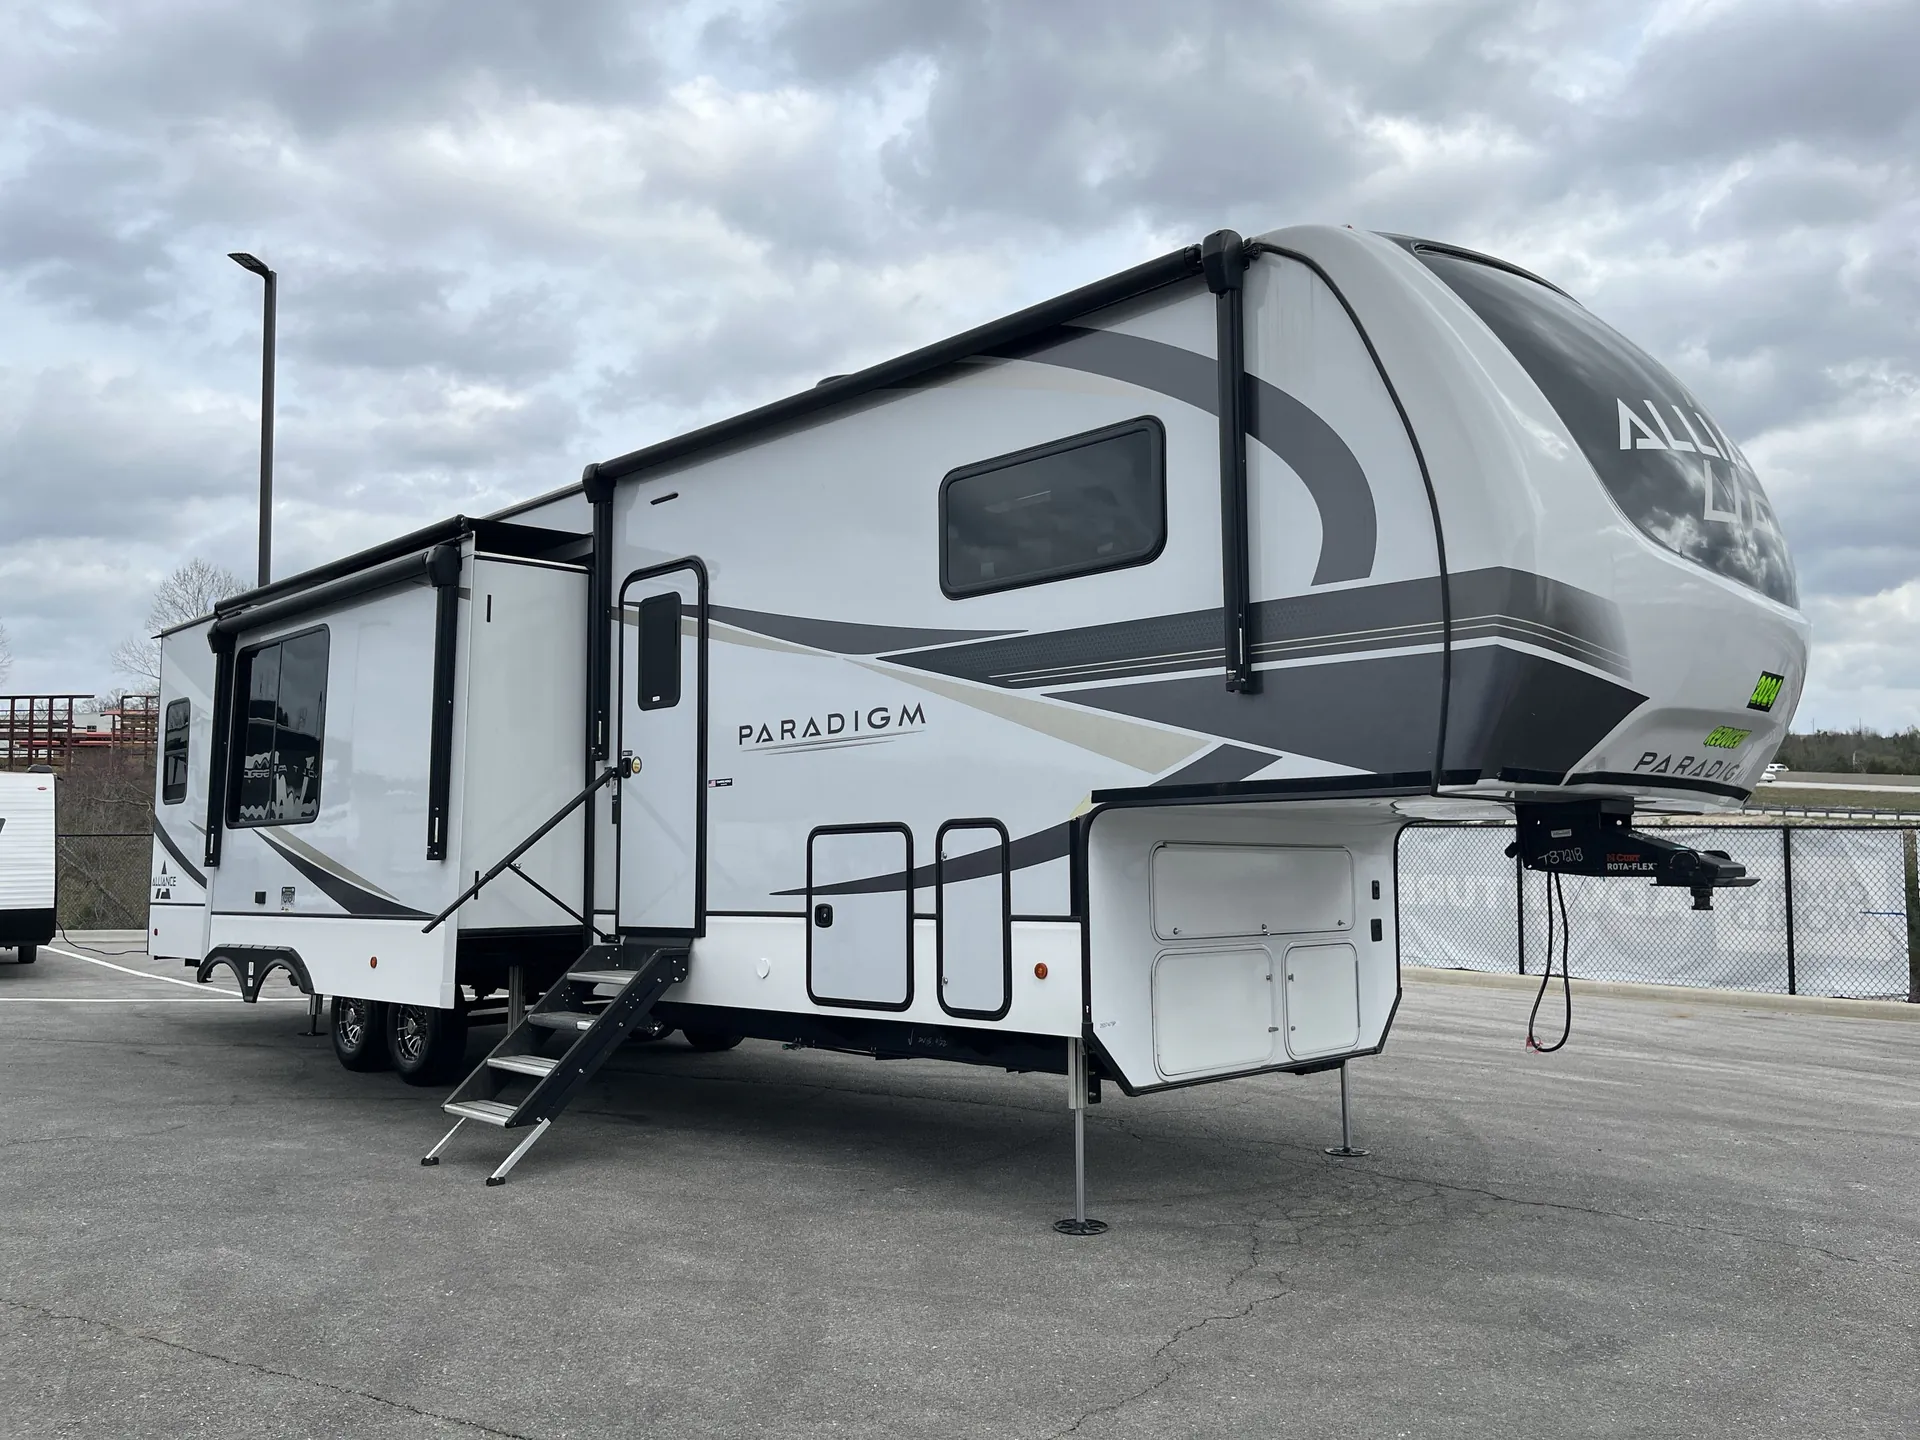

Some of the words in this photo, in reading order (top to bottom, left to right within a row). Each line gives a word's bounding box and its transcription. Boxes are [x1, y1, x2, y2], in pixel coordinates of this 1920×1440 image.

[1751, 675, 1783, 707] 2024
[739, 702, 926, 745] PARADIGM
[1538, 847, 1584, 865] T87218
[152, 876, 176, 887] ALLIANCE
